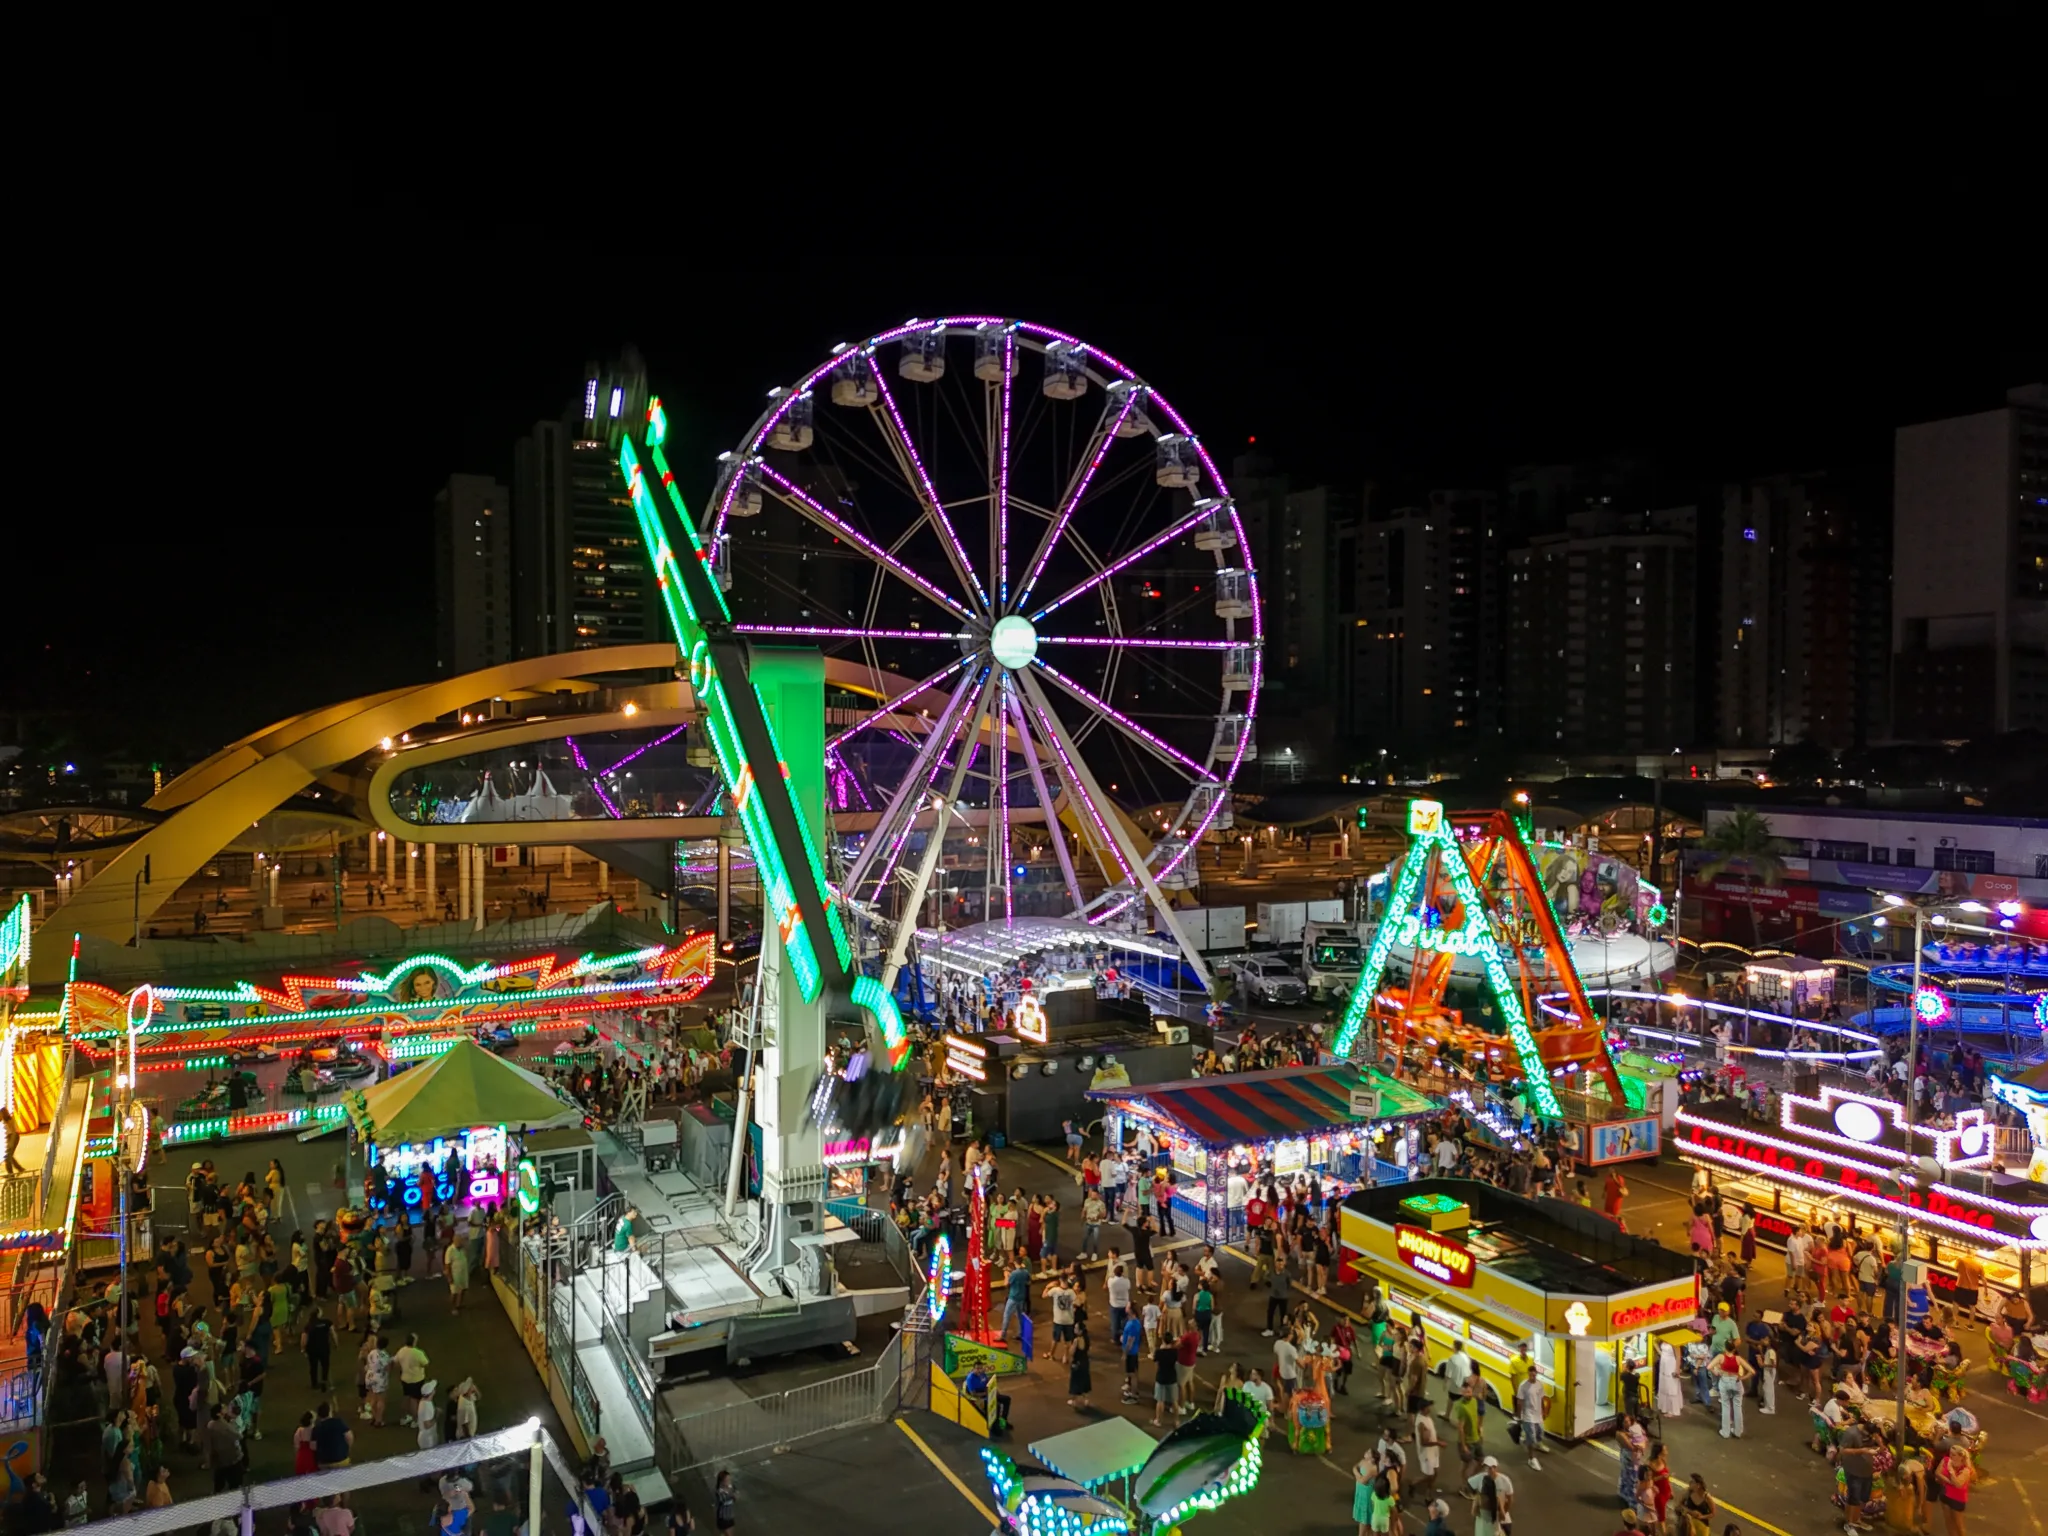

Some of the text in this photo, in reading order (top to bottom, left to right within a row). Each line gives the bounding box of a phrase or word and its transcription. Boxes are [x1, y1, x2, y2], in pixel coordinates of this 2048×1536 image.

[1534, 828, 1599, 851] ANCE
[1804, 1159, 1825, 1178] O
[1927, 1191, 1995, 1229] Doce
[1441, 1247, 1470, 1274] BOY
[1648, 1303, 1664, 1318] de
[1665, 1297, 1700, 1313] Cana
